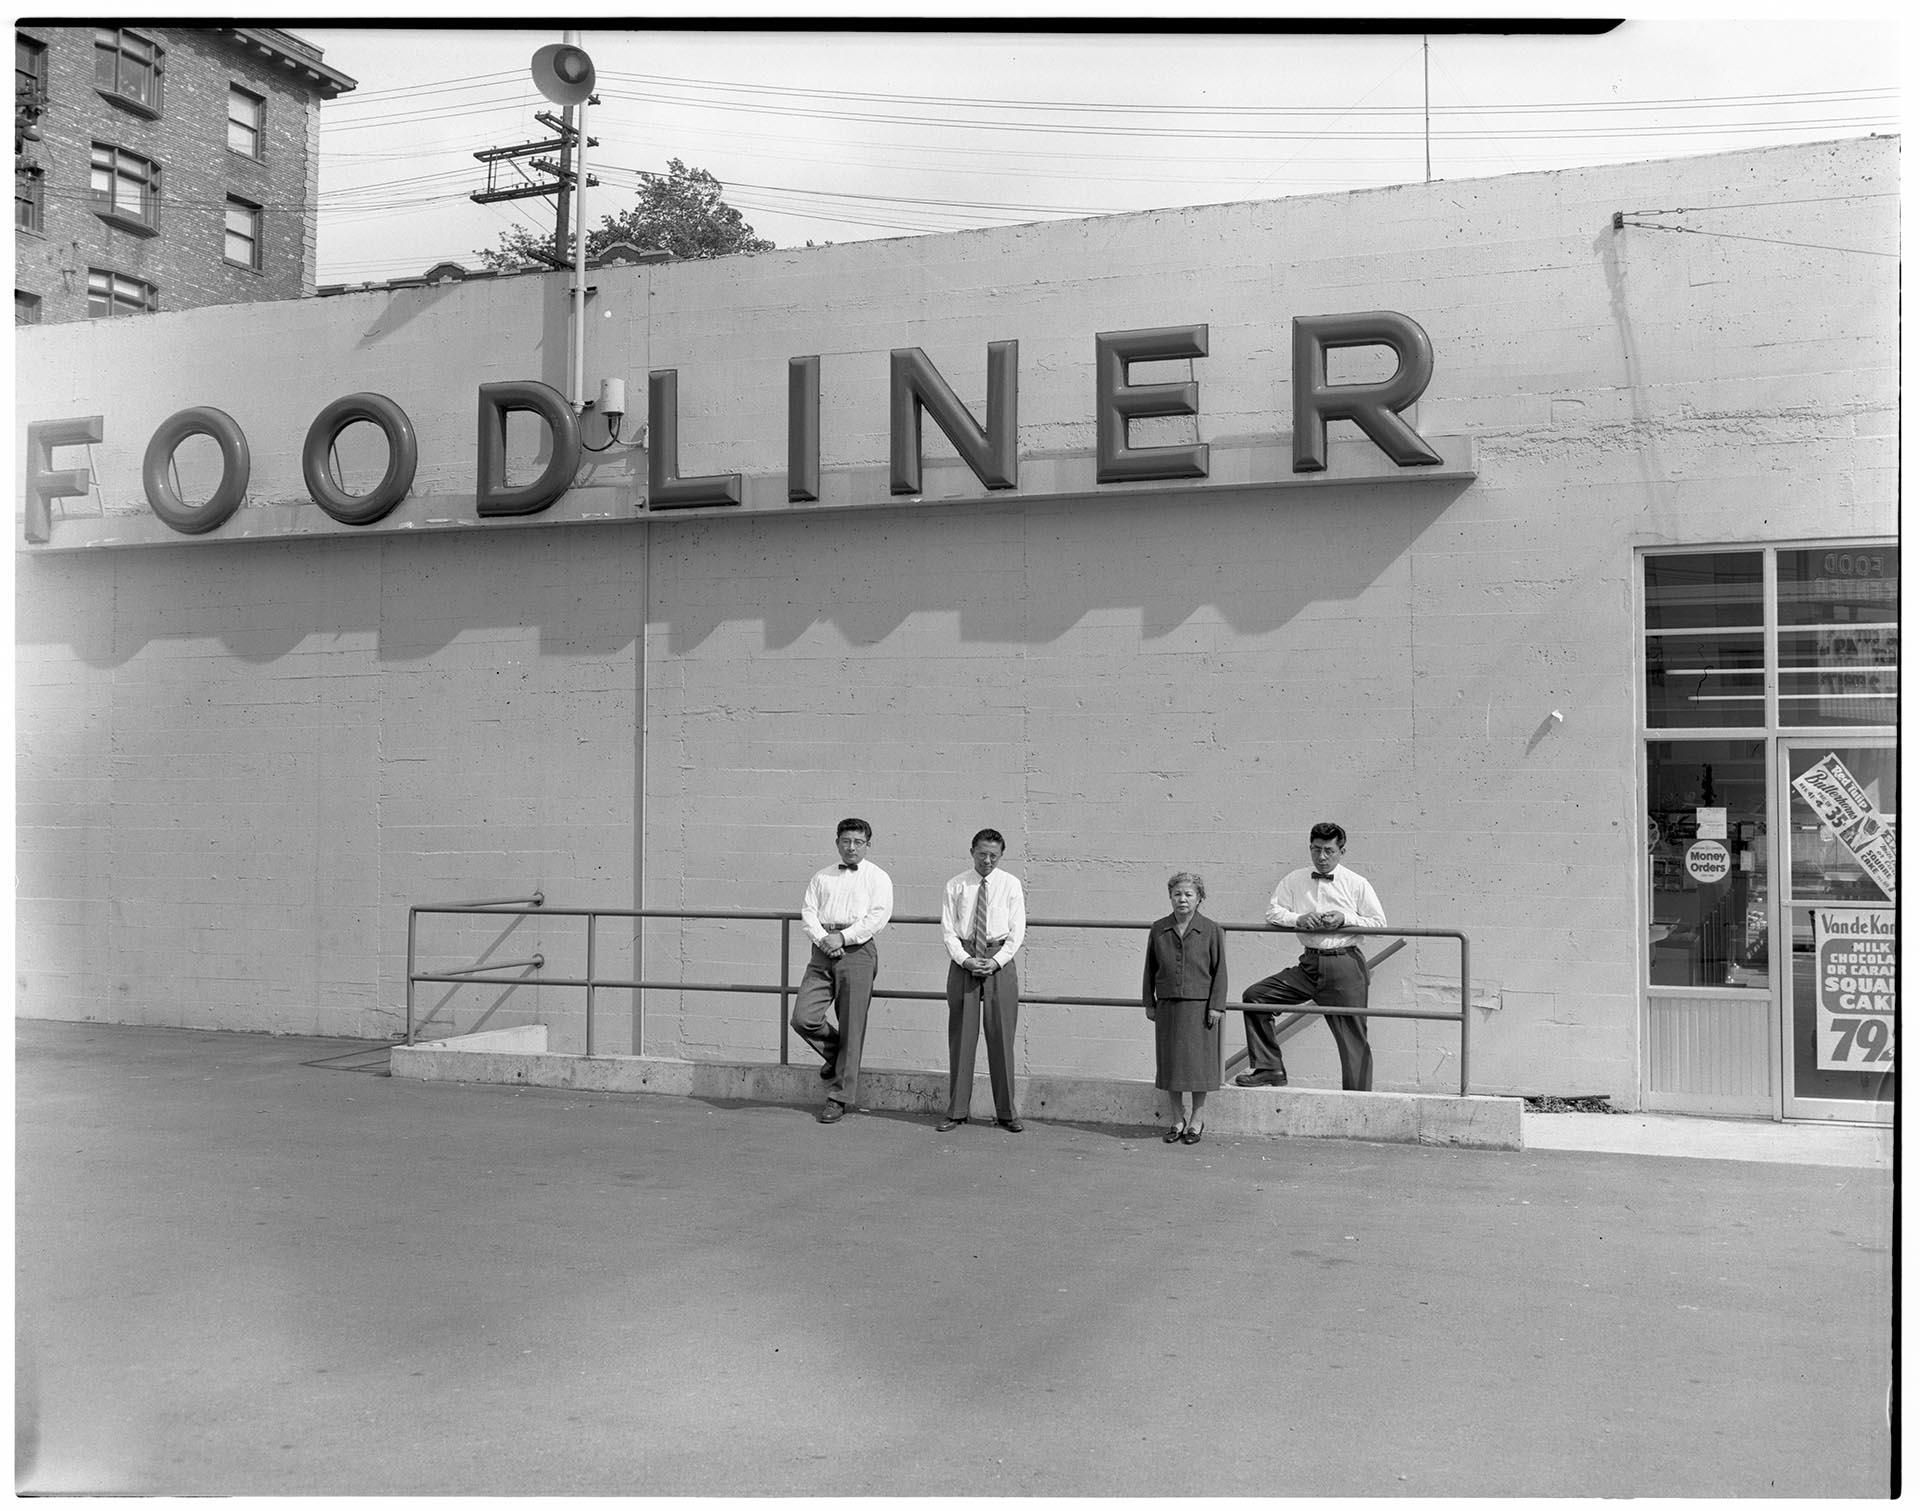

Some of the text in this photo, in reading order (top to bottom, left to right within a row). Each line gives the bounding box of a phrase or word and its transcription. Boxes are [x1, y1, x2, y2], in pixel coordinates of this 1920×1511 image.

[24, 310, 1444, 543] FOODLINER
[1831, 764, 1869, 810] Red Tulip
[1690, 852, 1726, 863] Money
[1861, 854, 1880, 875] CAKE
[1866, 850, 1892, 879] SQUARE
[1690, 862, 1726, 873] Orders
[1853, 942, 1891, 953] MILK
[1827, 964, 1847, 975] OR
